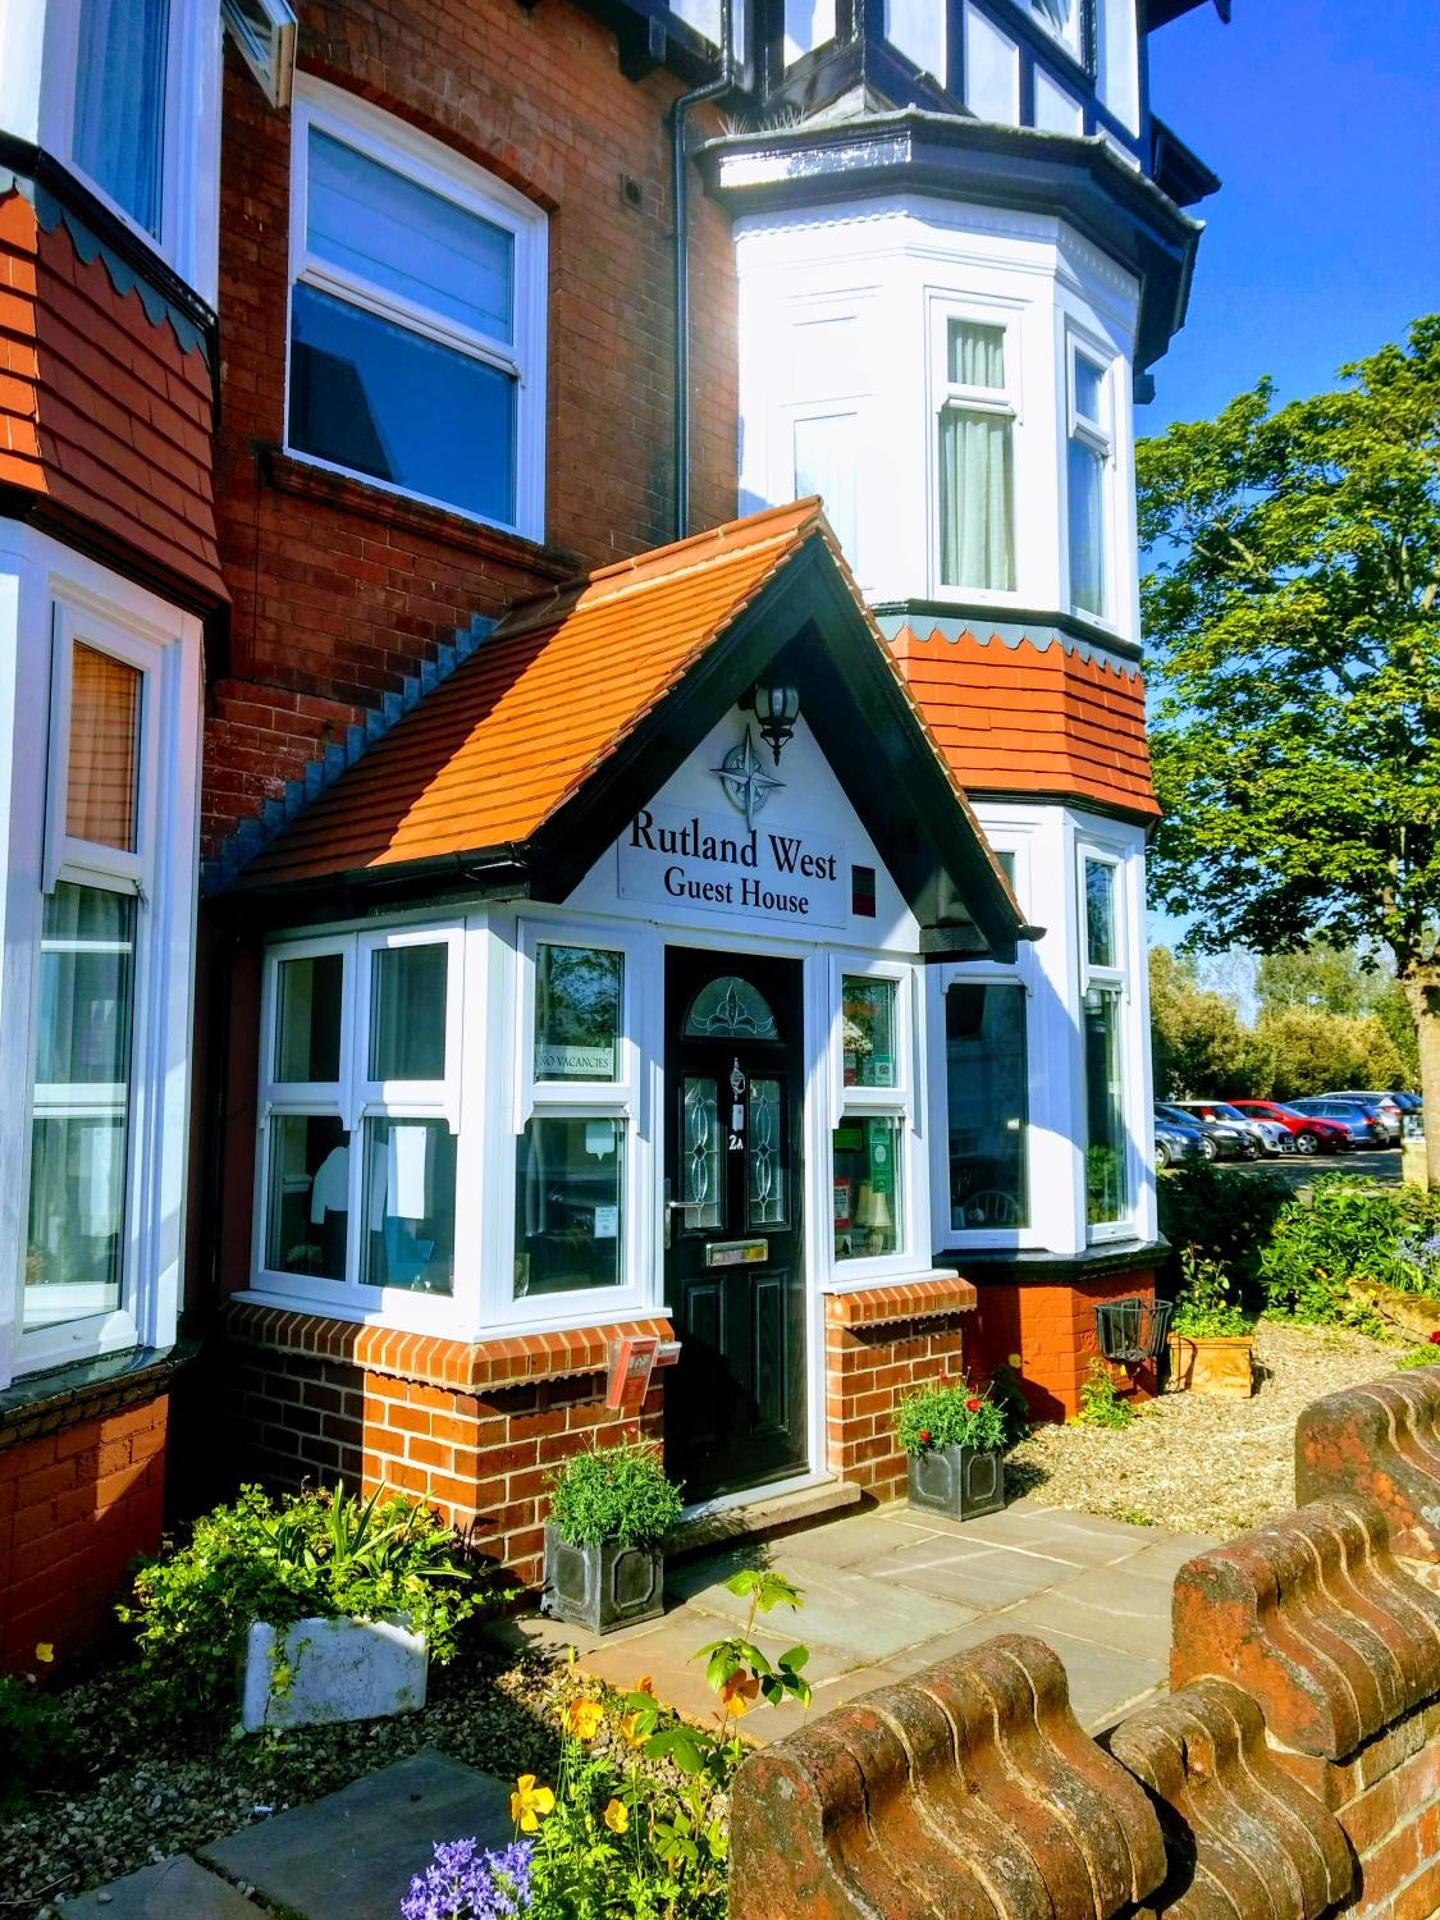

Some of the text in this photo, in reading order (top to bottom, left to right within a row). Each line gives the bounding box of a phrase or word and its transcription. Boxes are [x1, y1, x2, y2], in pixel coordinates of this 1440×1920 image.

[629, 809, 837, 881] Rutland West
[664, 866, 809, 914] Guest House
[540, 1055, 609, 1068] NO VACANCIES
